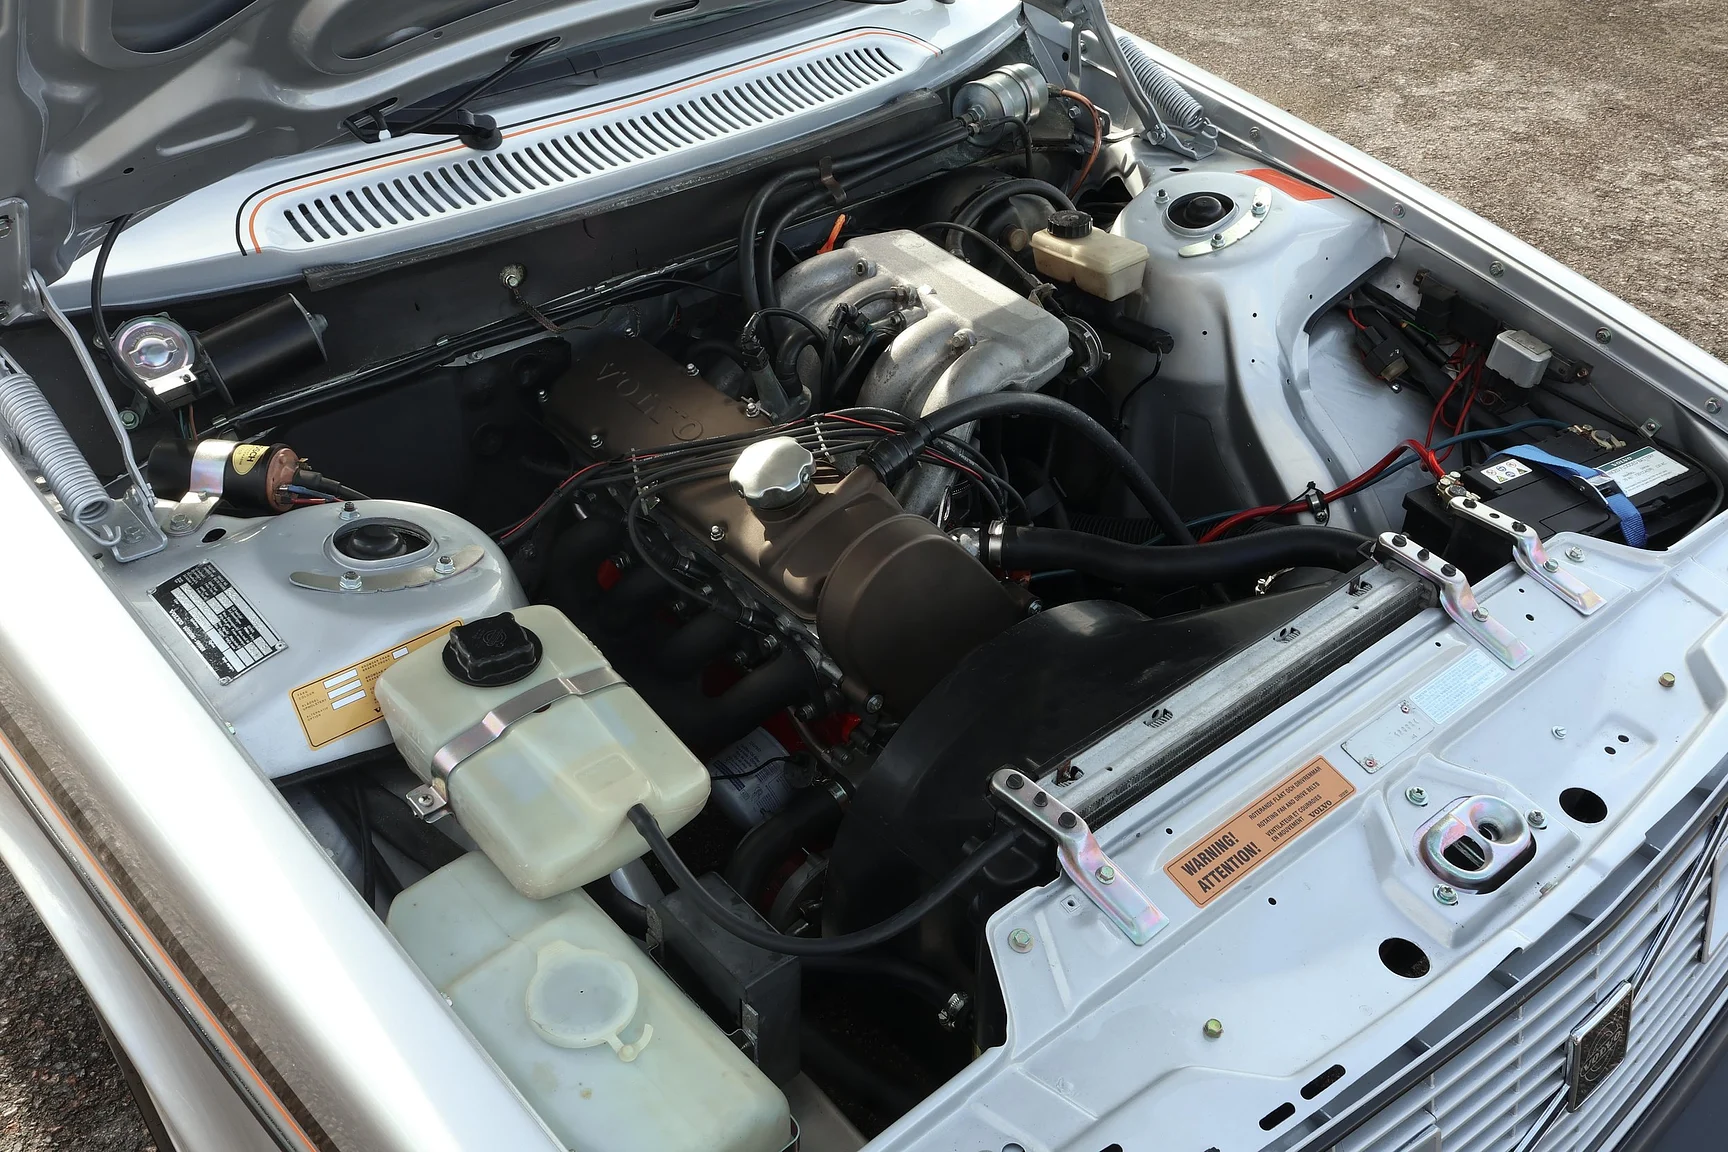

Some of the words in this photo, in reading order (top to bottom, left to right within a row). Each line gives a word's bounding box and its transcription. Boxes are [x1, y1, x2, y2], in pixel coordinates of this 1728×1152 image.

[1611, 456, 1632, 467] VOLVO
[1248, 801, 1275, 820] ROTERANDE
[1272, 792, 1287, 804] FLÄKT
[1285, 785, 1296, 795] OCH
[1293, 766, 1322, 788] DRIVREMMAR
[1256, 811, 1279, 829] ROTATING
[1277, 804, 1289, 815] FAN
[1285, 798, 1296, 810] AND
[1294, 789, 1309, 802] DRIVE
[1307, 781, 1321, 793] BELTS
[1308, 799, 1333, 818] VOLVO
[1265, 814, 1294, 837] VENTILATEUR
[1292, 809, 1300, 818] ET
[1297, 794, 1322, 813] COURROIES
[1271, 834, 1280, 842] EN
[1276, 816, 1305, 838] MOUVEMENT
[1180, 831, 1239, 876] WARNING!
[1197, 841, 1261, 893] ATTENTION!
[1583, 1030, 1621, 1071] VOLVO
